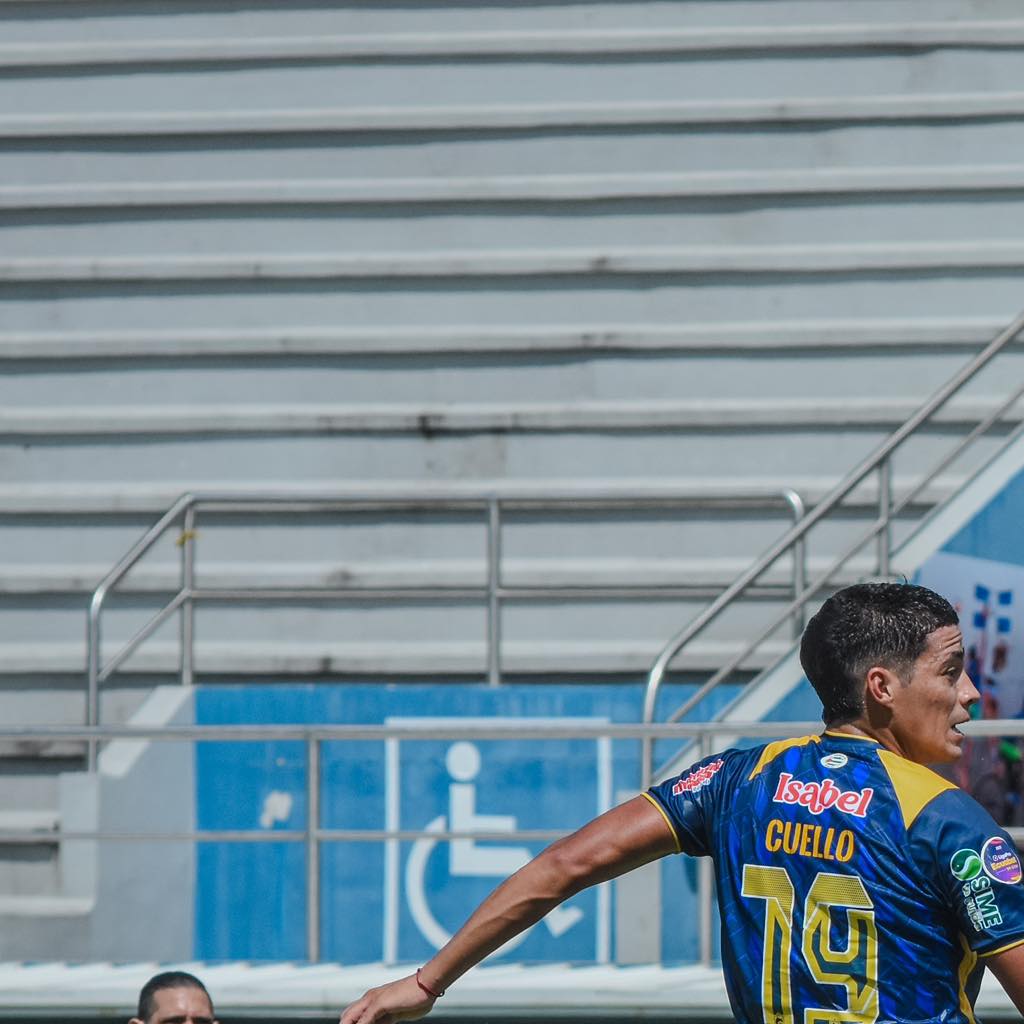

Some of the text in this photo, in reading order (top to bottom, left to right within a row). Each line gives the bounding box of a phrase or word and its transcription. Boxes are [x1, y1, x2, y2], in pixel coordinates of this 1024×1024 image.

[773, 773, 874, 818] Isabel
[765, 820, 854, 862] CUELLO
[971, 876, 1003, 929] SIME
